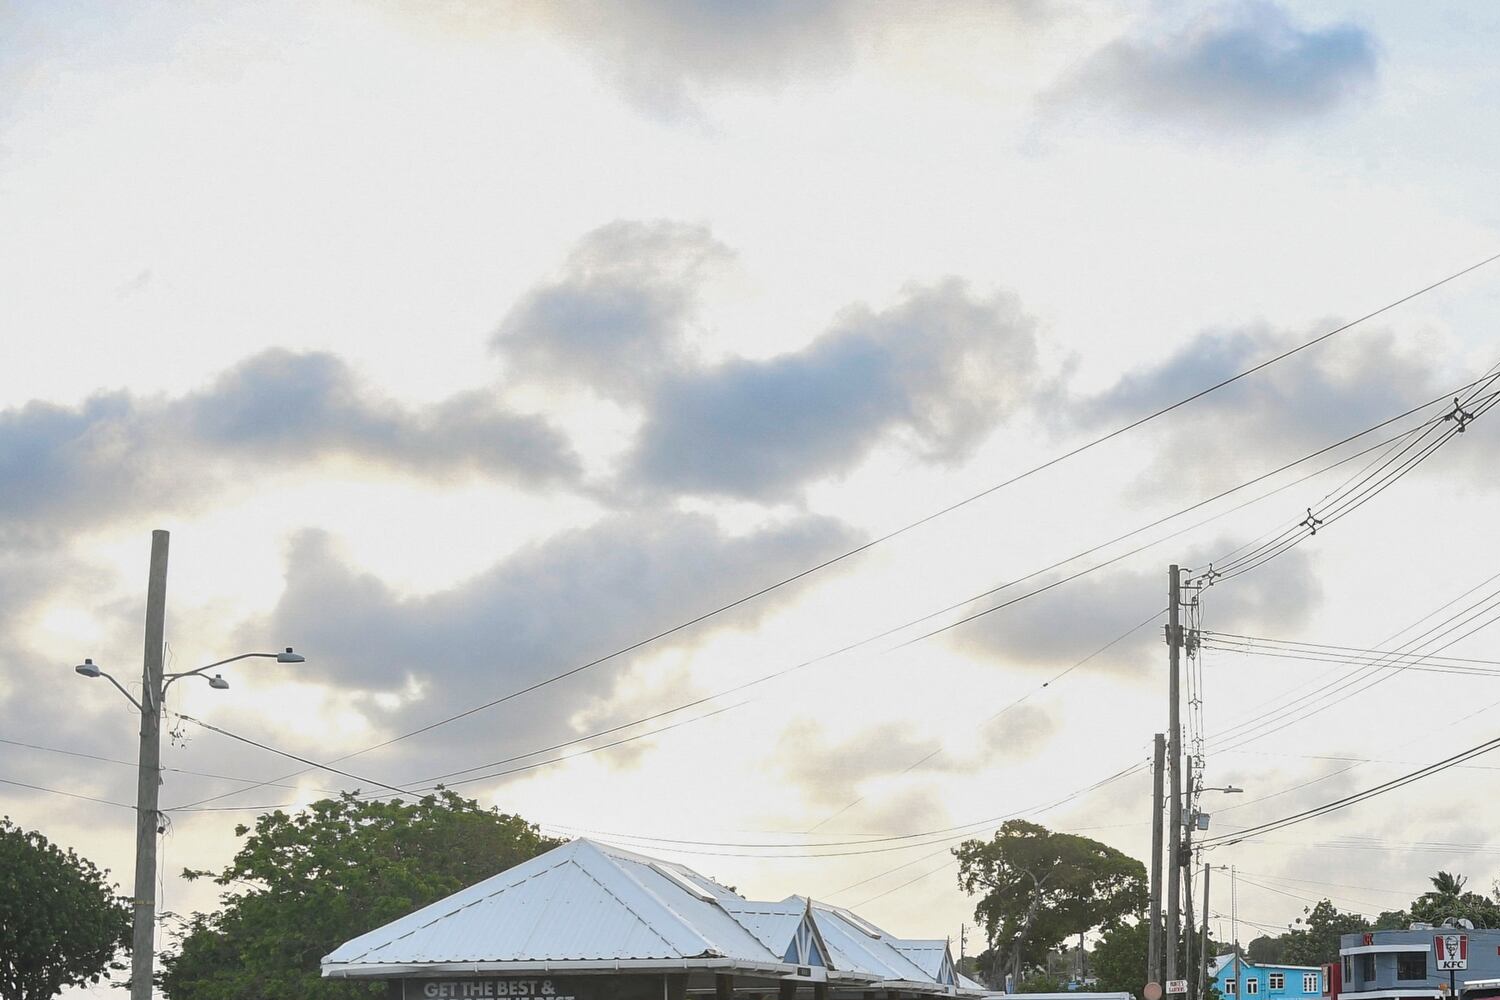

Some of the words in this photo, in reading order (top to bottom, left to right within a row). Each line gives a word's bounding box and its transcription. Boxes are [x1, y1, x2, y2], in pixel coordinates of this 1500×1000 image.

[1443, 961, 1464, 969] KFC
[424, 982, 457, 997] GET
[460, 981, 493, 997] THE
[497, 980, 538, 996] BEST
[541, 980, 556, 995] &
